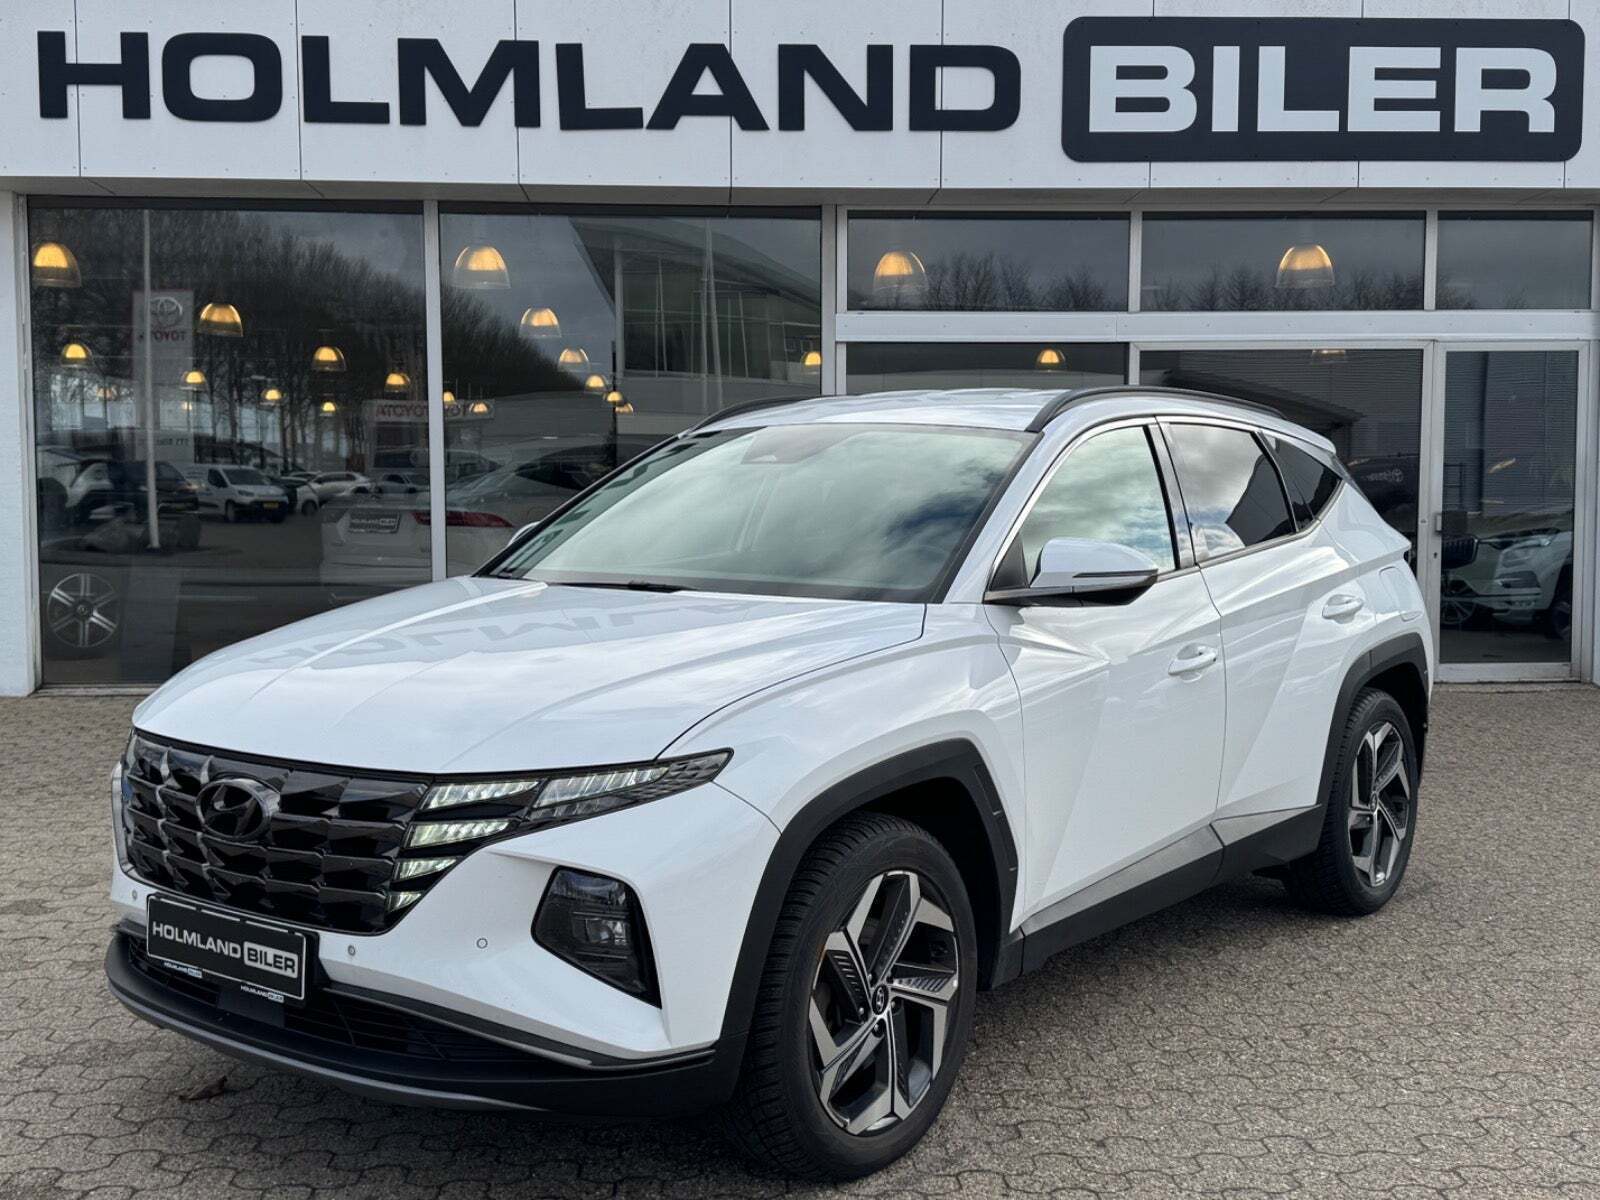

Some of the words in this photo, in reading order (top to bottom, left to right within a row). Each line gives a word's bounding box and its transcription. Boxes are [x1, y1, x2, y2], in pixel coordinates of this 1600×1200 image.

[37, 31, 1021, 132] HOLMLAND
[1088, 45, 1557, 134] BILER
[152, 921, 241, 959] HOLMLAND
[246, 951, 296, 974] BILER
